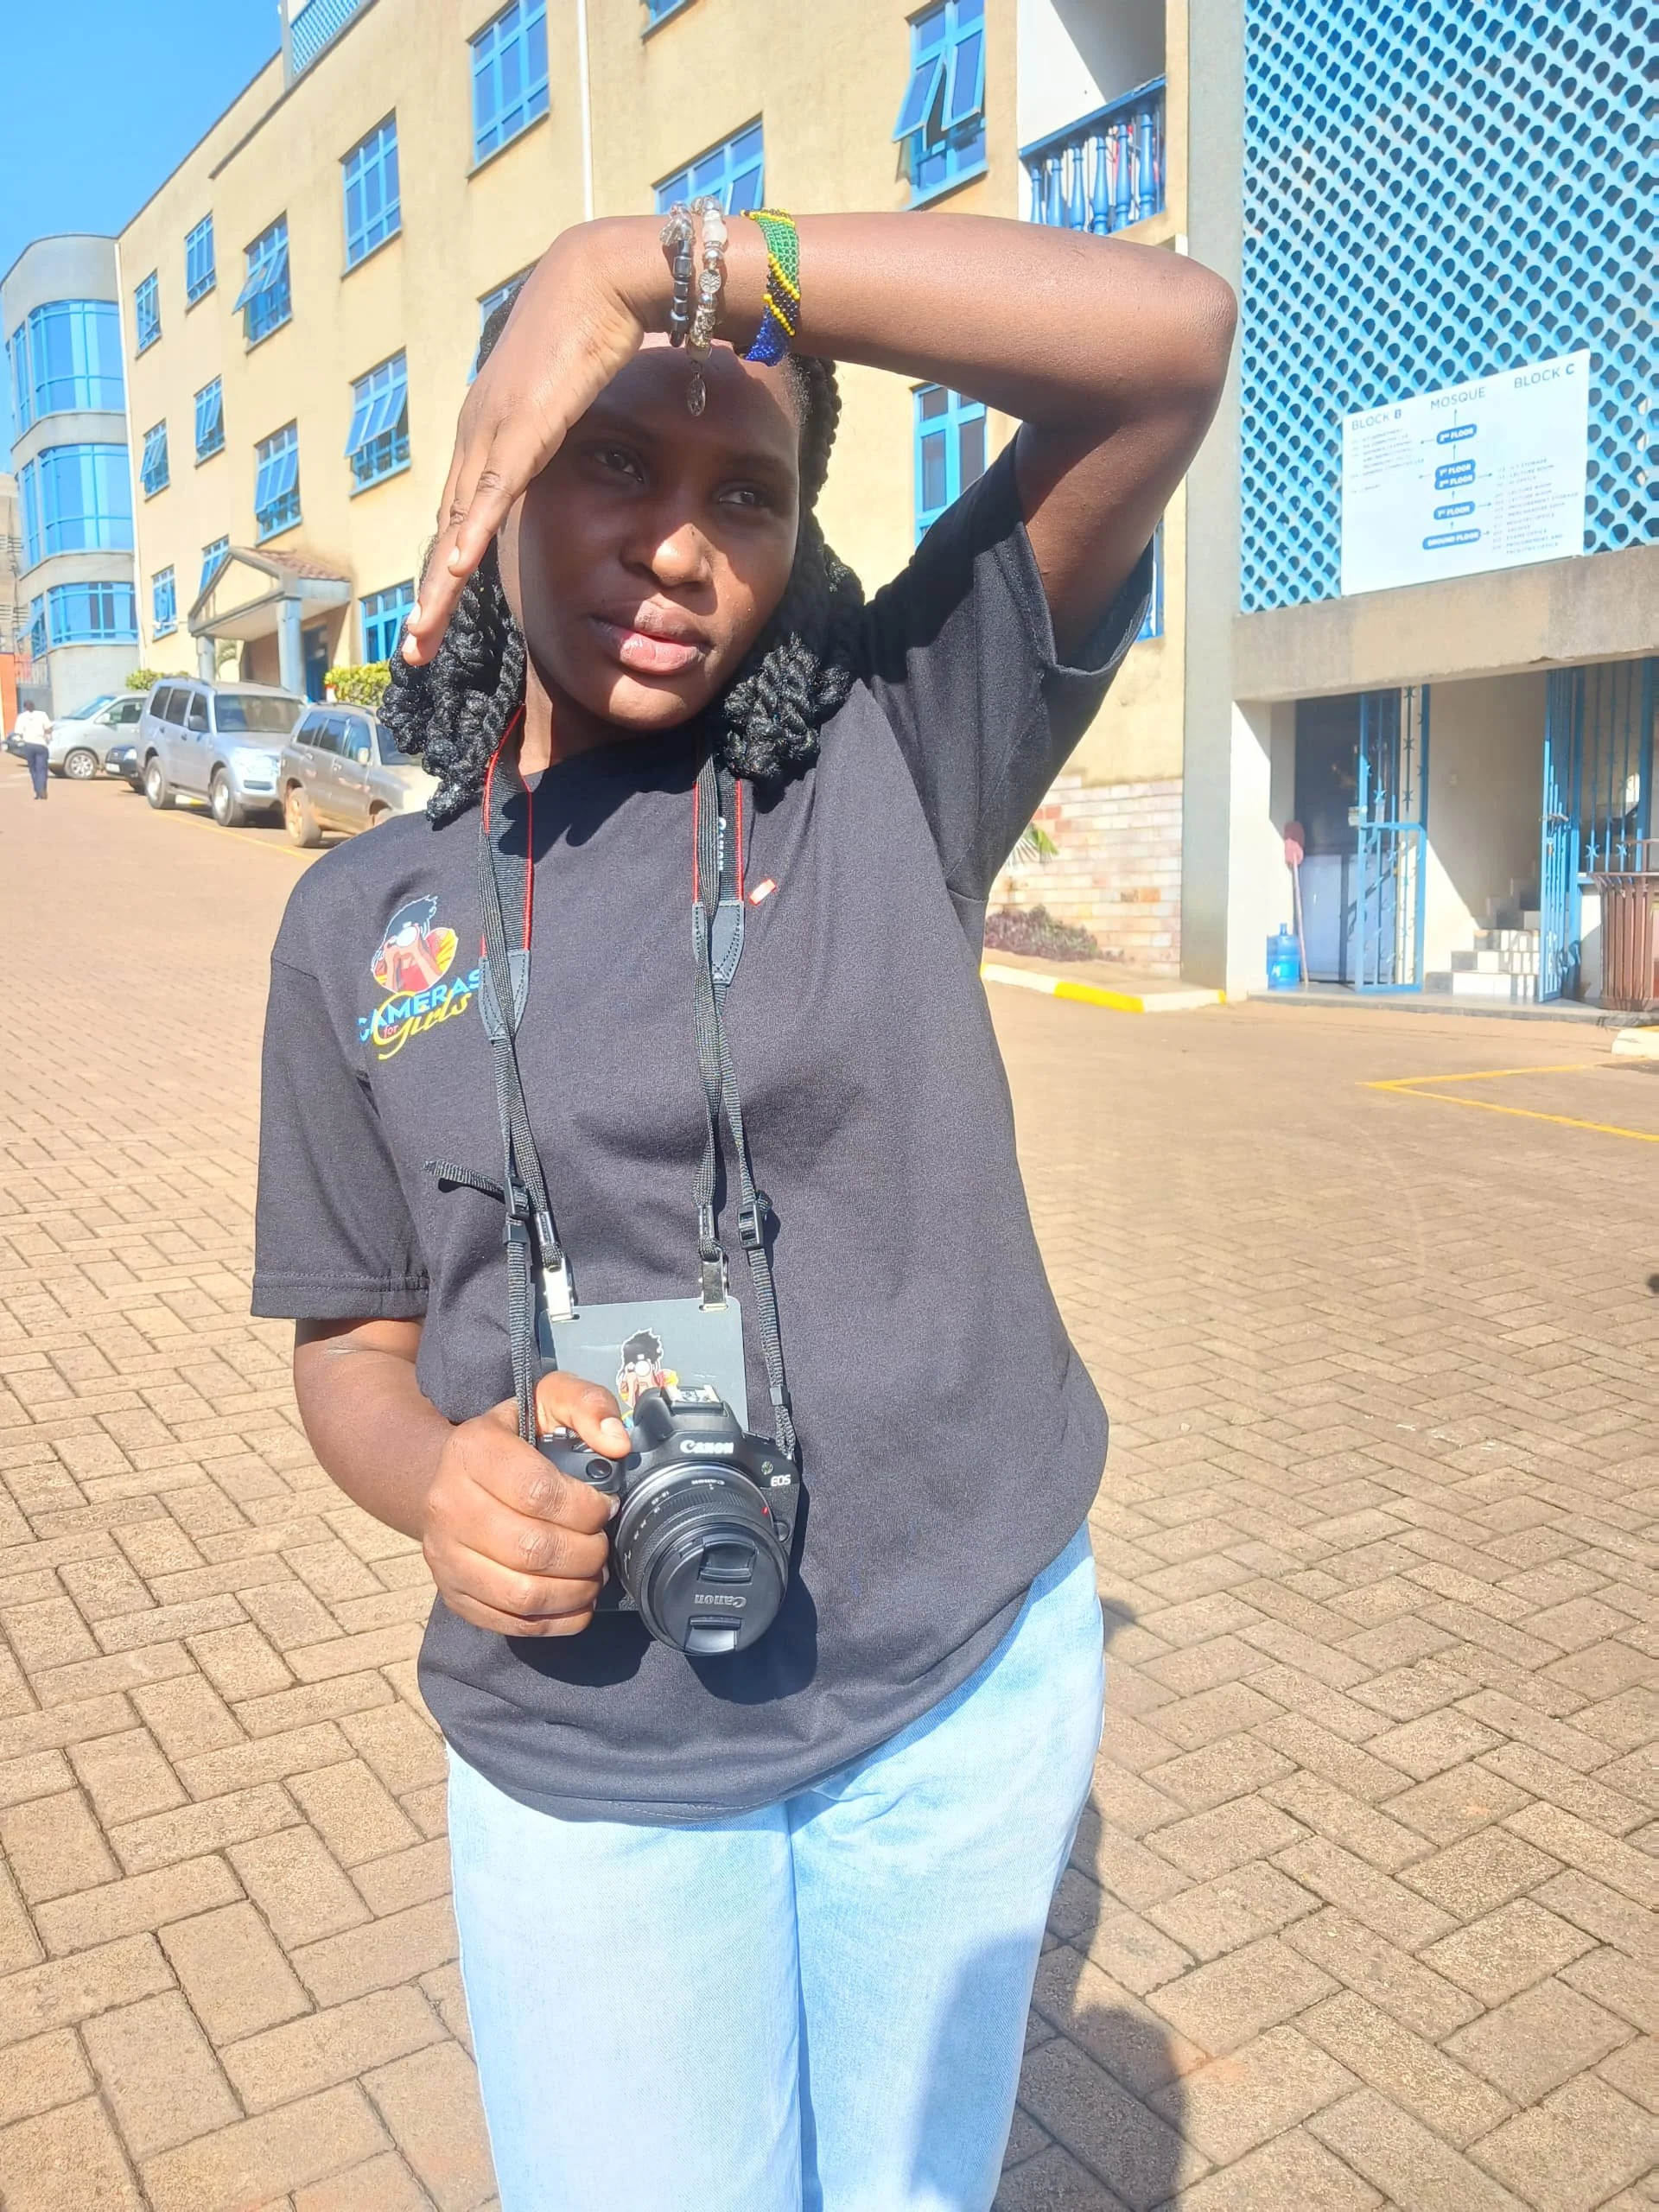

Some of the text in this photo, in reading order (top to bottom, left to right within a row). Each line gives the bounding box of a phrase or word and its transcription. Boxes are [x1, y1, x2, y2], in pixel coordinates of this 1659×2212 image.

[1514, 363, 1575, 389] BLOCK C
[1430, 386, 1486, 410] MOSQUE
[1351, 409, 1402, 431] BLOCK B
[1450, 427, 1474, 439] FLOOR
[1448, 463, 1471, 475] FLOOR
[1450, 474, 1473, 486] FLOOR
[1446, 505, 1471, 517] FLOOR
[1456, 531, 1479, 543] FLOOR
[358, 968, 481, 1042] CAMERAS
[382, 1024, 399, 1038] for
[679, 1439, 734, 1454] Canon
[770, 1474, 791, 1487] EOS
[694, 1593, 747, 1608] Canon
